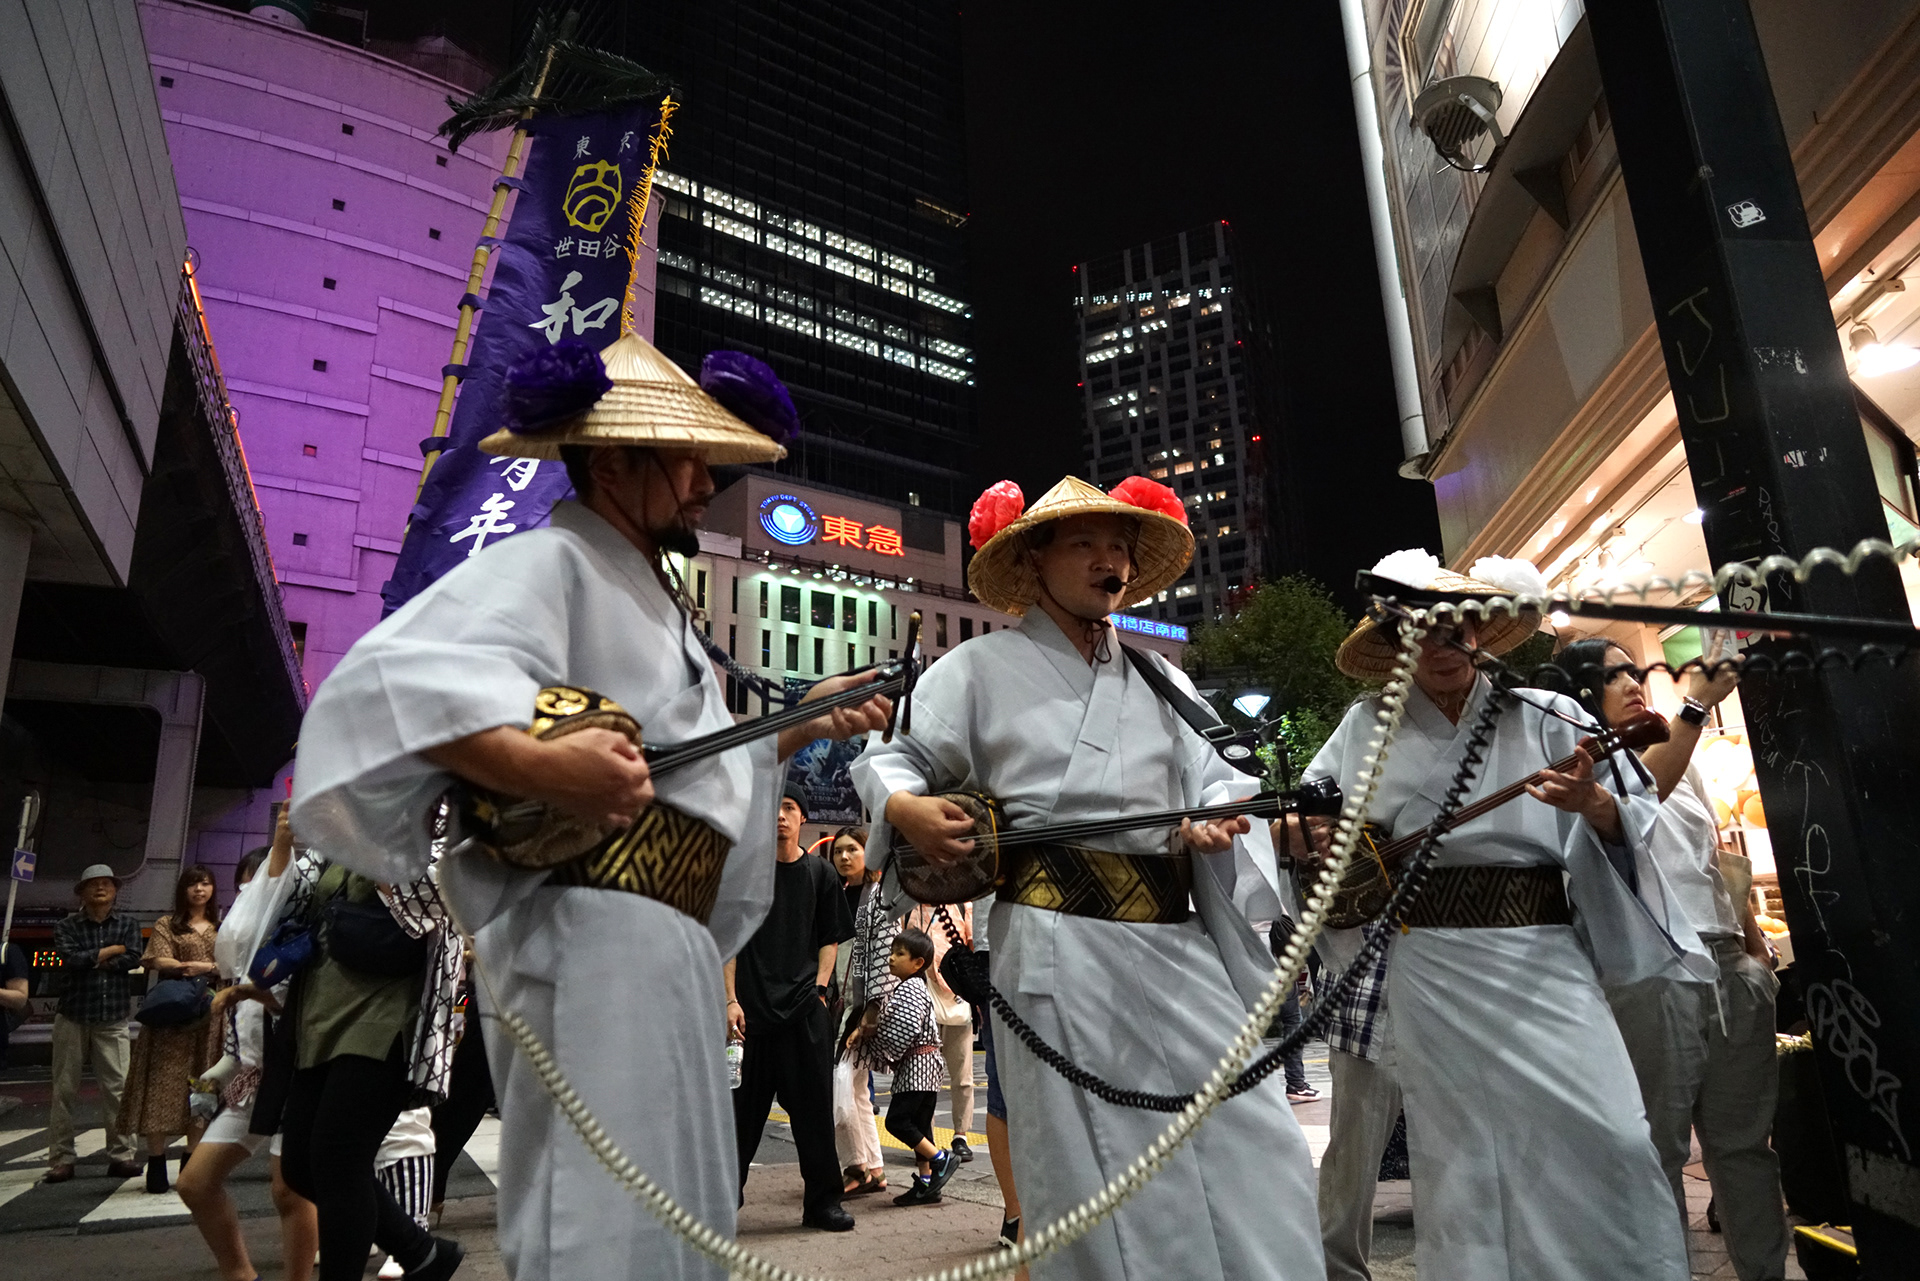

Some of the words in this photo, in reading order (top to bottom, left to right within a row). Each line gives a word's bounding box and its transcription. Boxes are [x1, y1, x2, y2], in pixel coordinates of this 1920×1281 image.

[572, 131, 635, 161] 東京
[553, 233, 623, 260] 世田谷
[528, 270, 620, 345] 和
[760, 494, 779, 509] TOKYU
[798, 500, 817, 521] STORE
[821, 514, 905, 556] 東急
